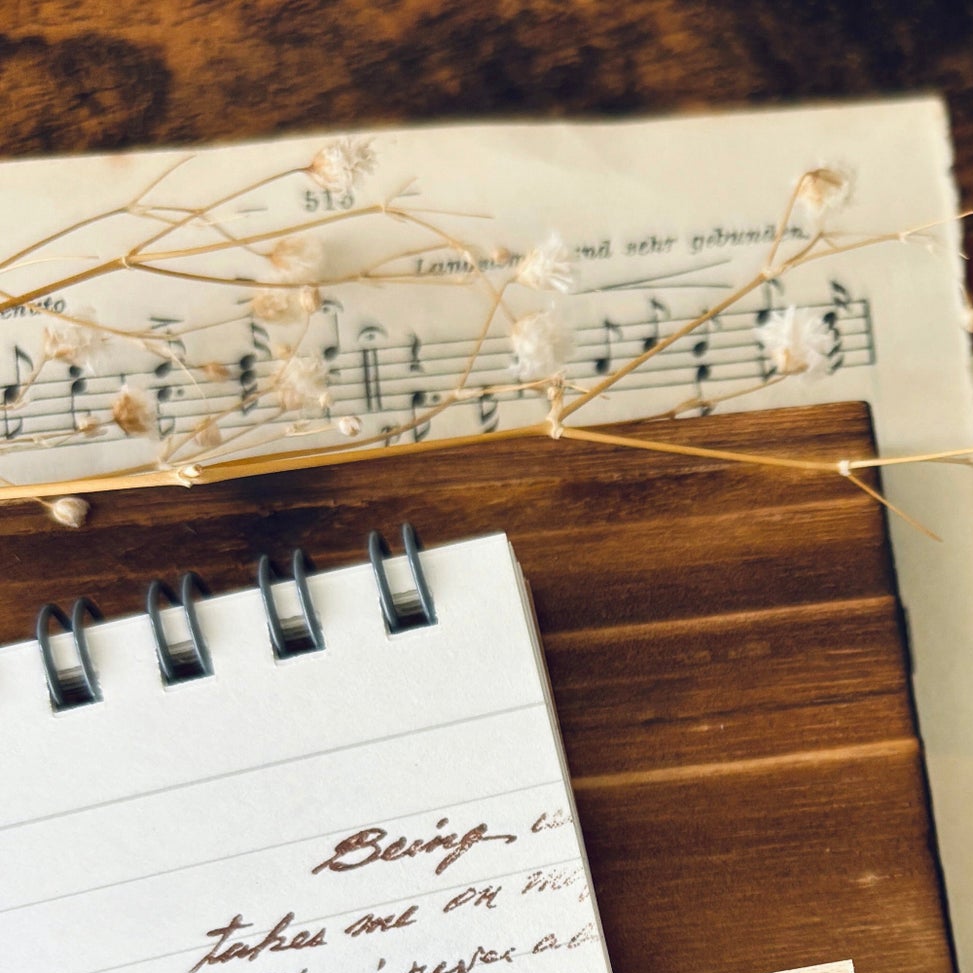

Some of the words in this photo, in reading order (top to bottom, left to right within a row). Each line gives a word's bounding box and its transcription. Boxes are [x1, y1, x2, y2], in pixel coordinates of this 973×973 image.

[312, 817, 517, 875] Being
[189, 912, 327, 973] takes
[345, 905, 418, 937] me
[444, 886, 502, 913] on
